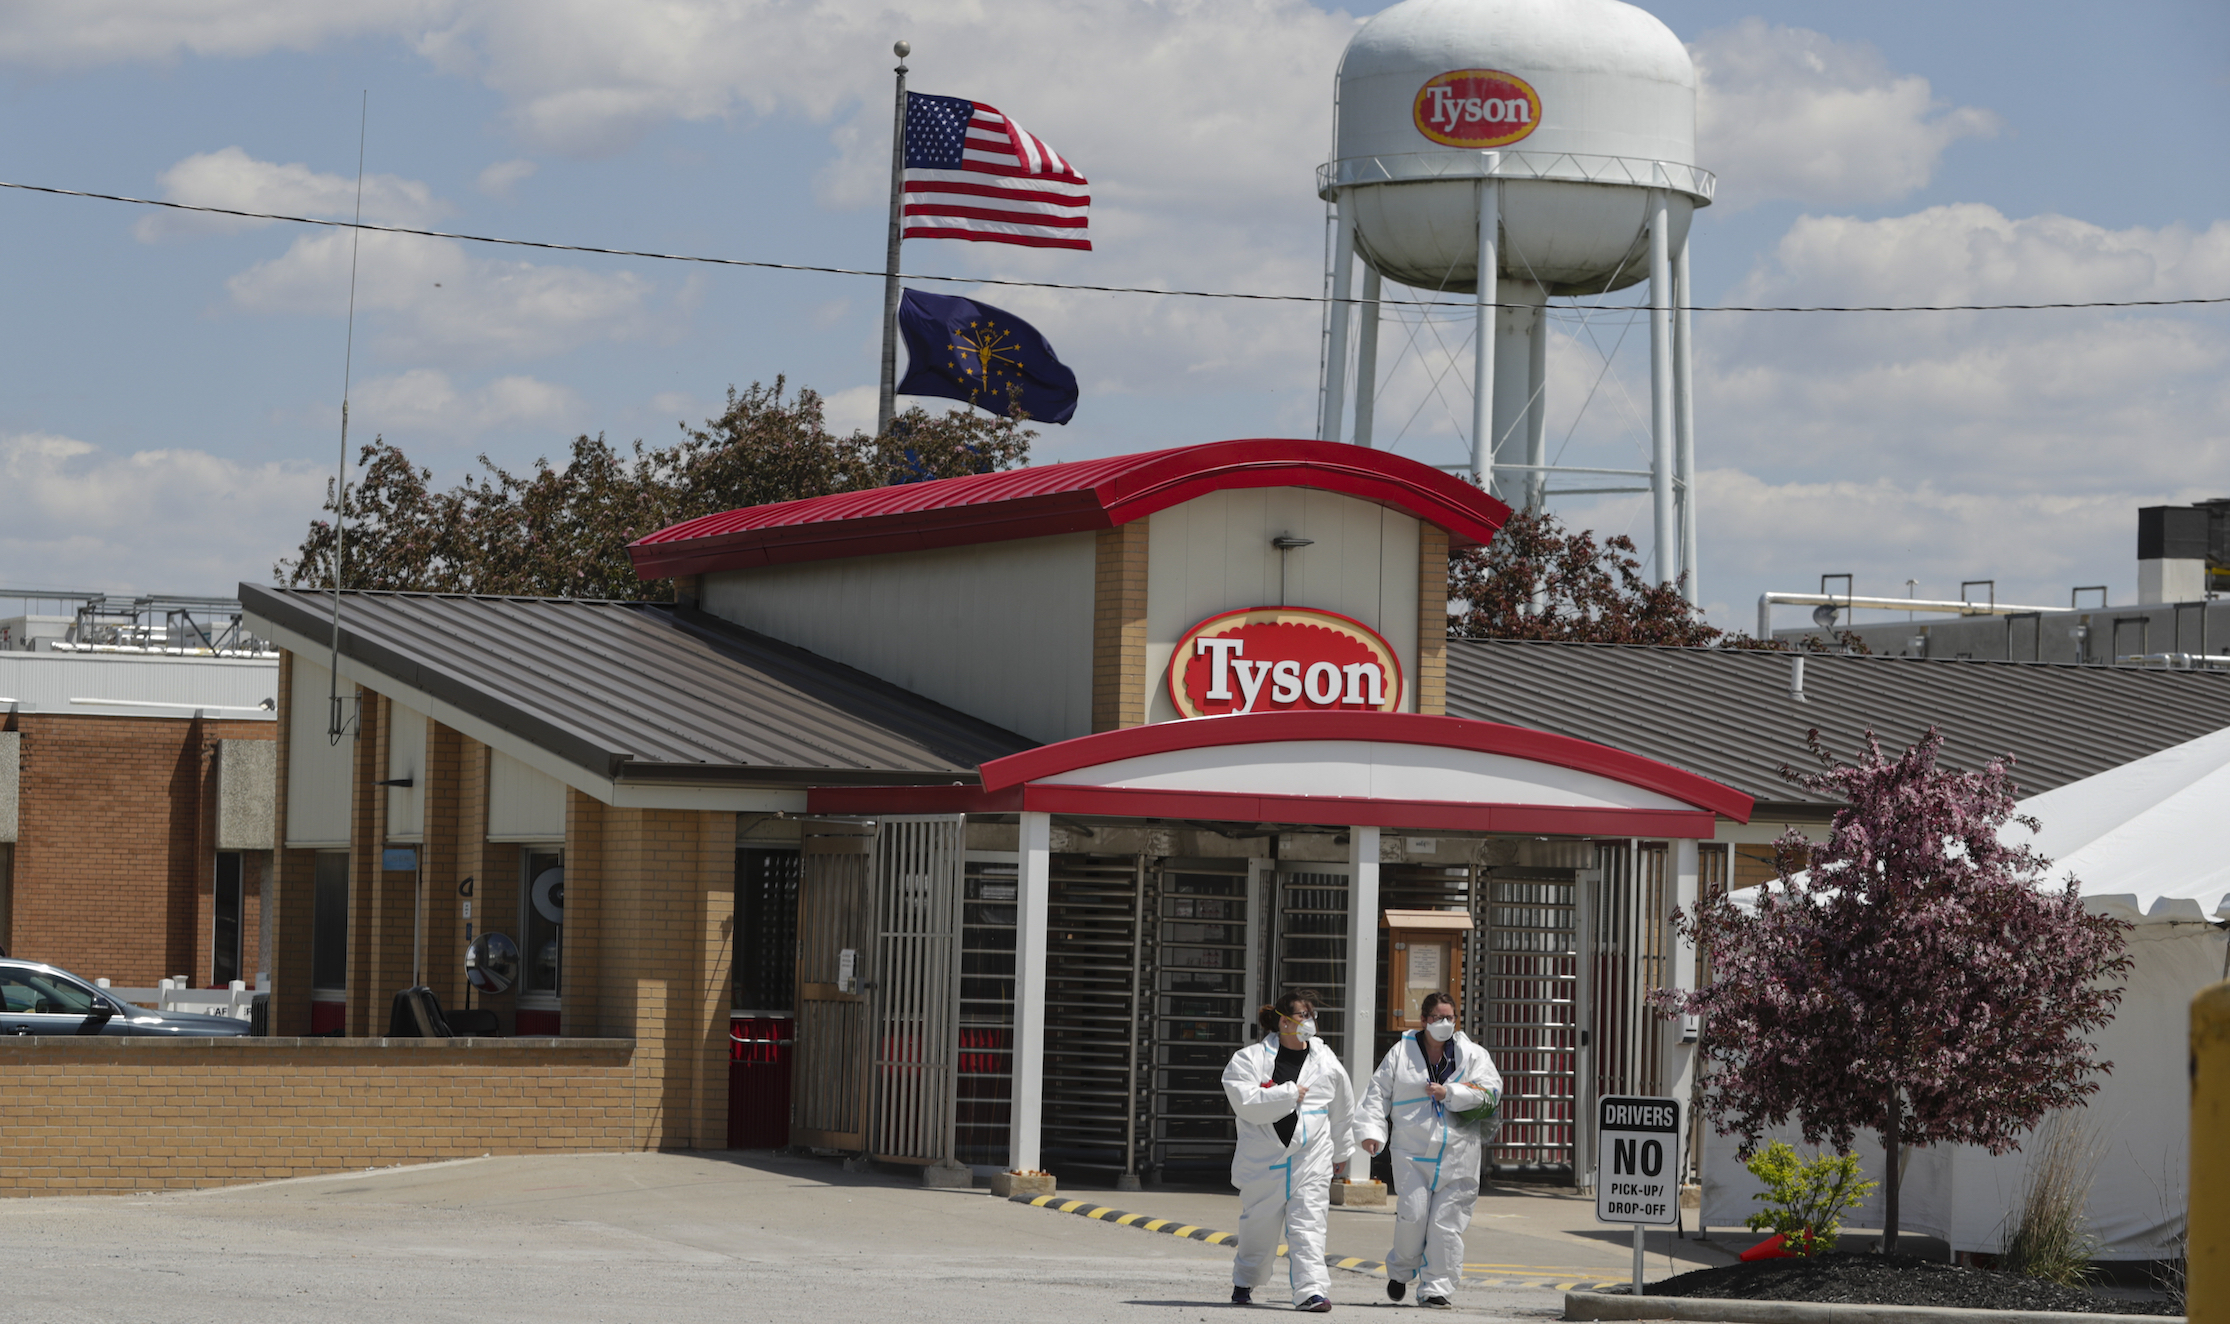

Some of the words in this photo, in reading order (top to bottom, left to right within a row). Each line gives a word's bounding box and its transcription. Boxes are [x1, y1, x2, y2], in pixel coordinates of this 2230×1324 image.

[1427, 86, 1531, 132] Tyson
[1196, 637, 1385, 714] Tyson
[1605, 1104, 1674, 1127] DRIVERS
[1614, 1138, 1663, 1177] NO
[1611, 1183, 1664, 1197] PICK-UP/
[1608, 1201, 1666, 1216] DROP-OFF
